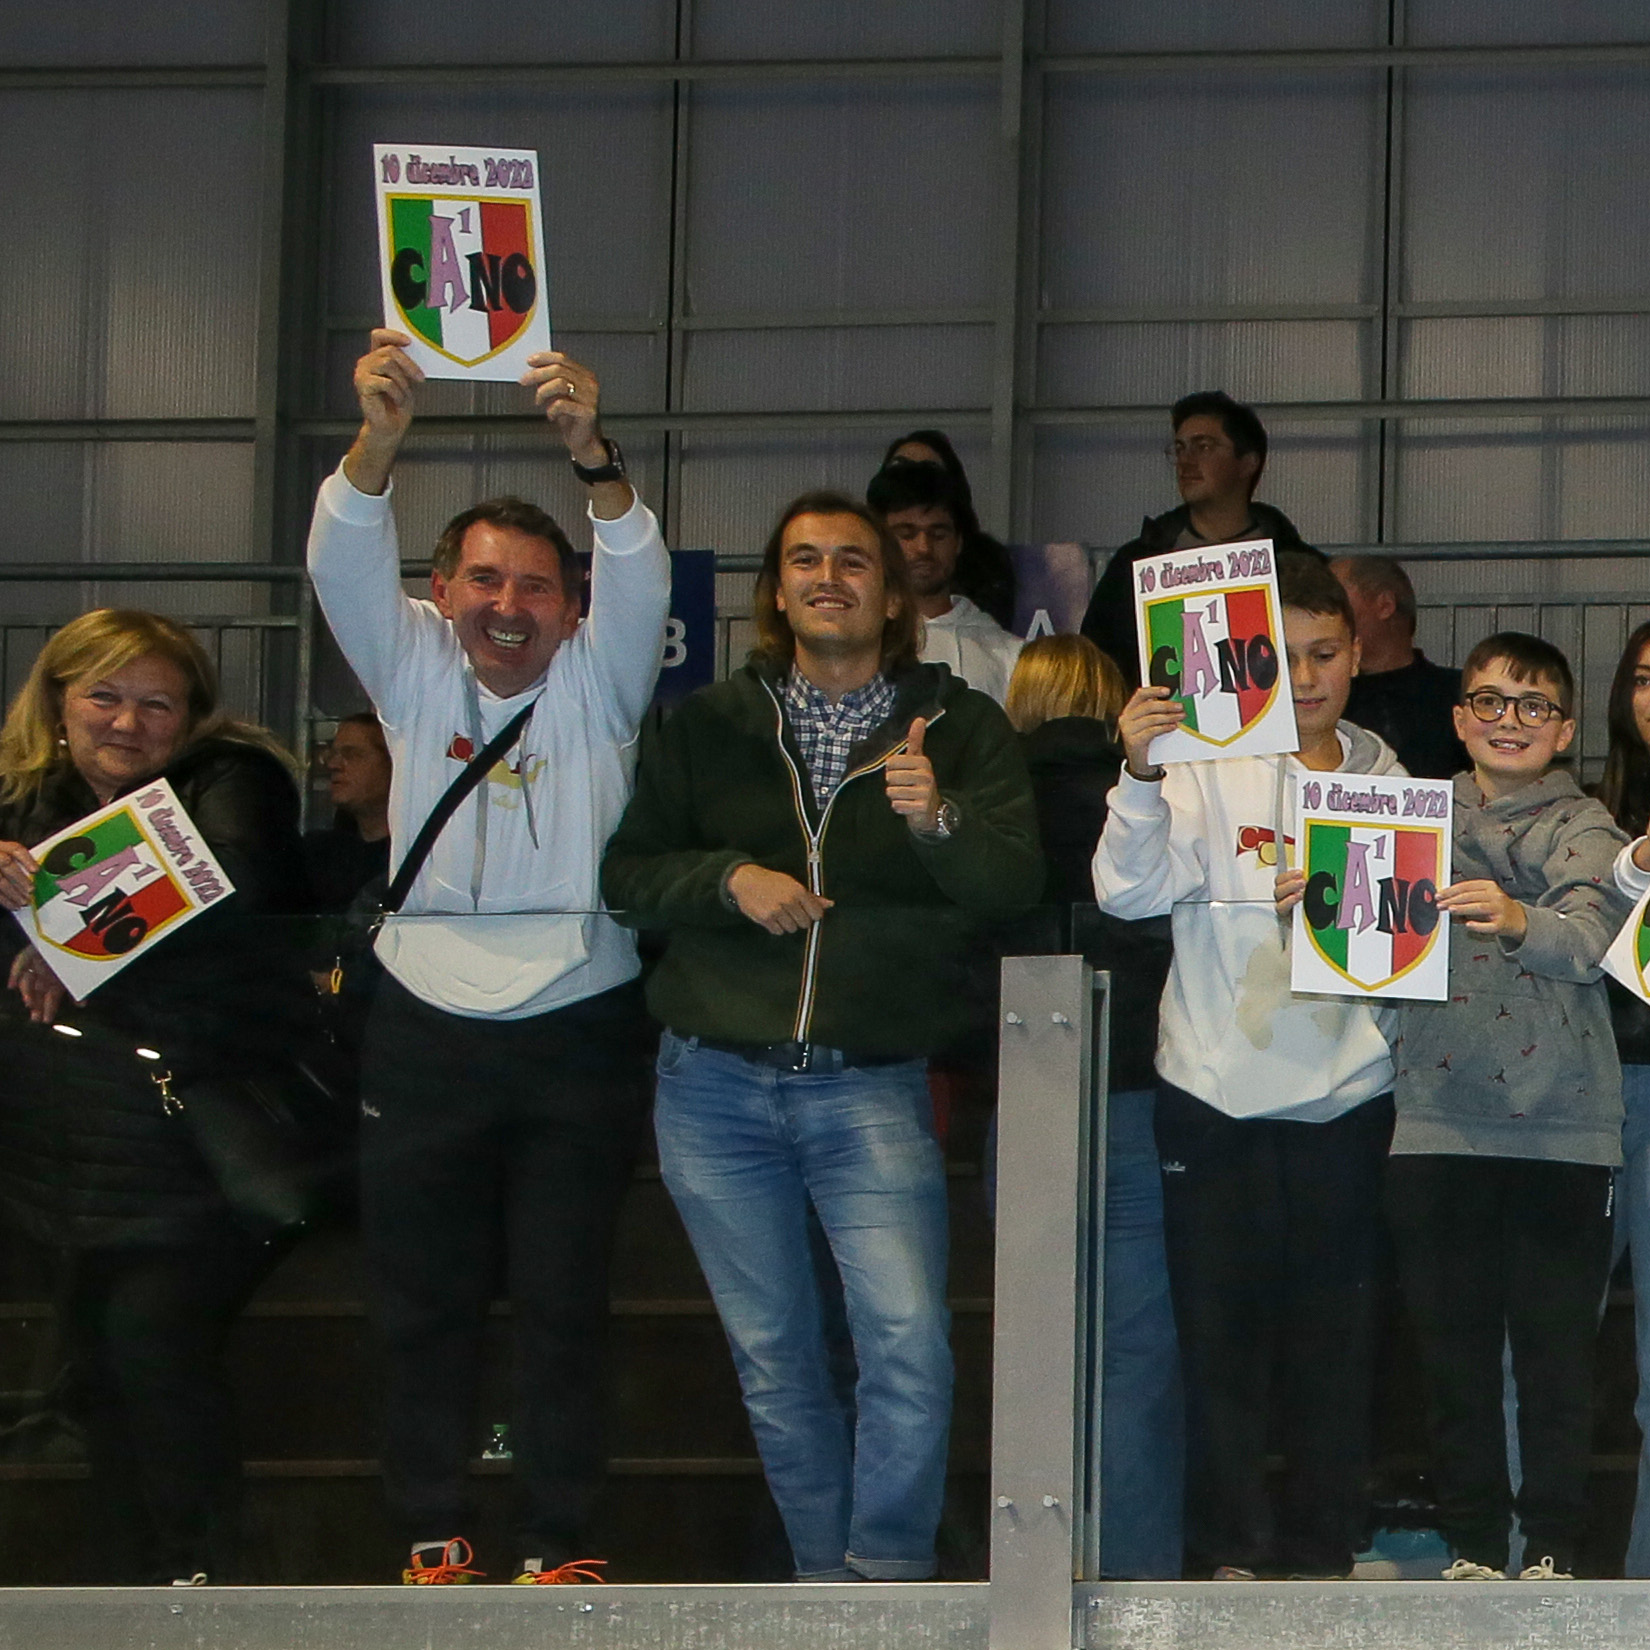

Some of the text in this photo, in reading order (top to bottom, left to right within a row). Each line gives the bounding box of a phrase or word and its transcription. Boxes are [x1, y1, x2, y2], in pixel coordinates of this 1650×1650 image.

[379, 153, 533, 189] 10 dicembre 2022
[1137, 546, 1271, 591] 10 dicembre 2022
[661, 618, 687, 668] B
[1302, 780, 1447, 818] 10 dicembre 2022
[135, 786, 165, 809] 10
[181, 859, 226, 905] 2022
